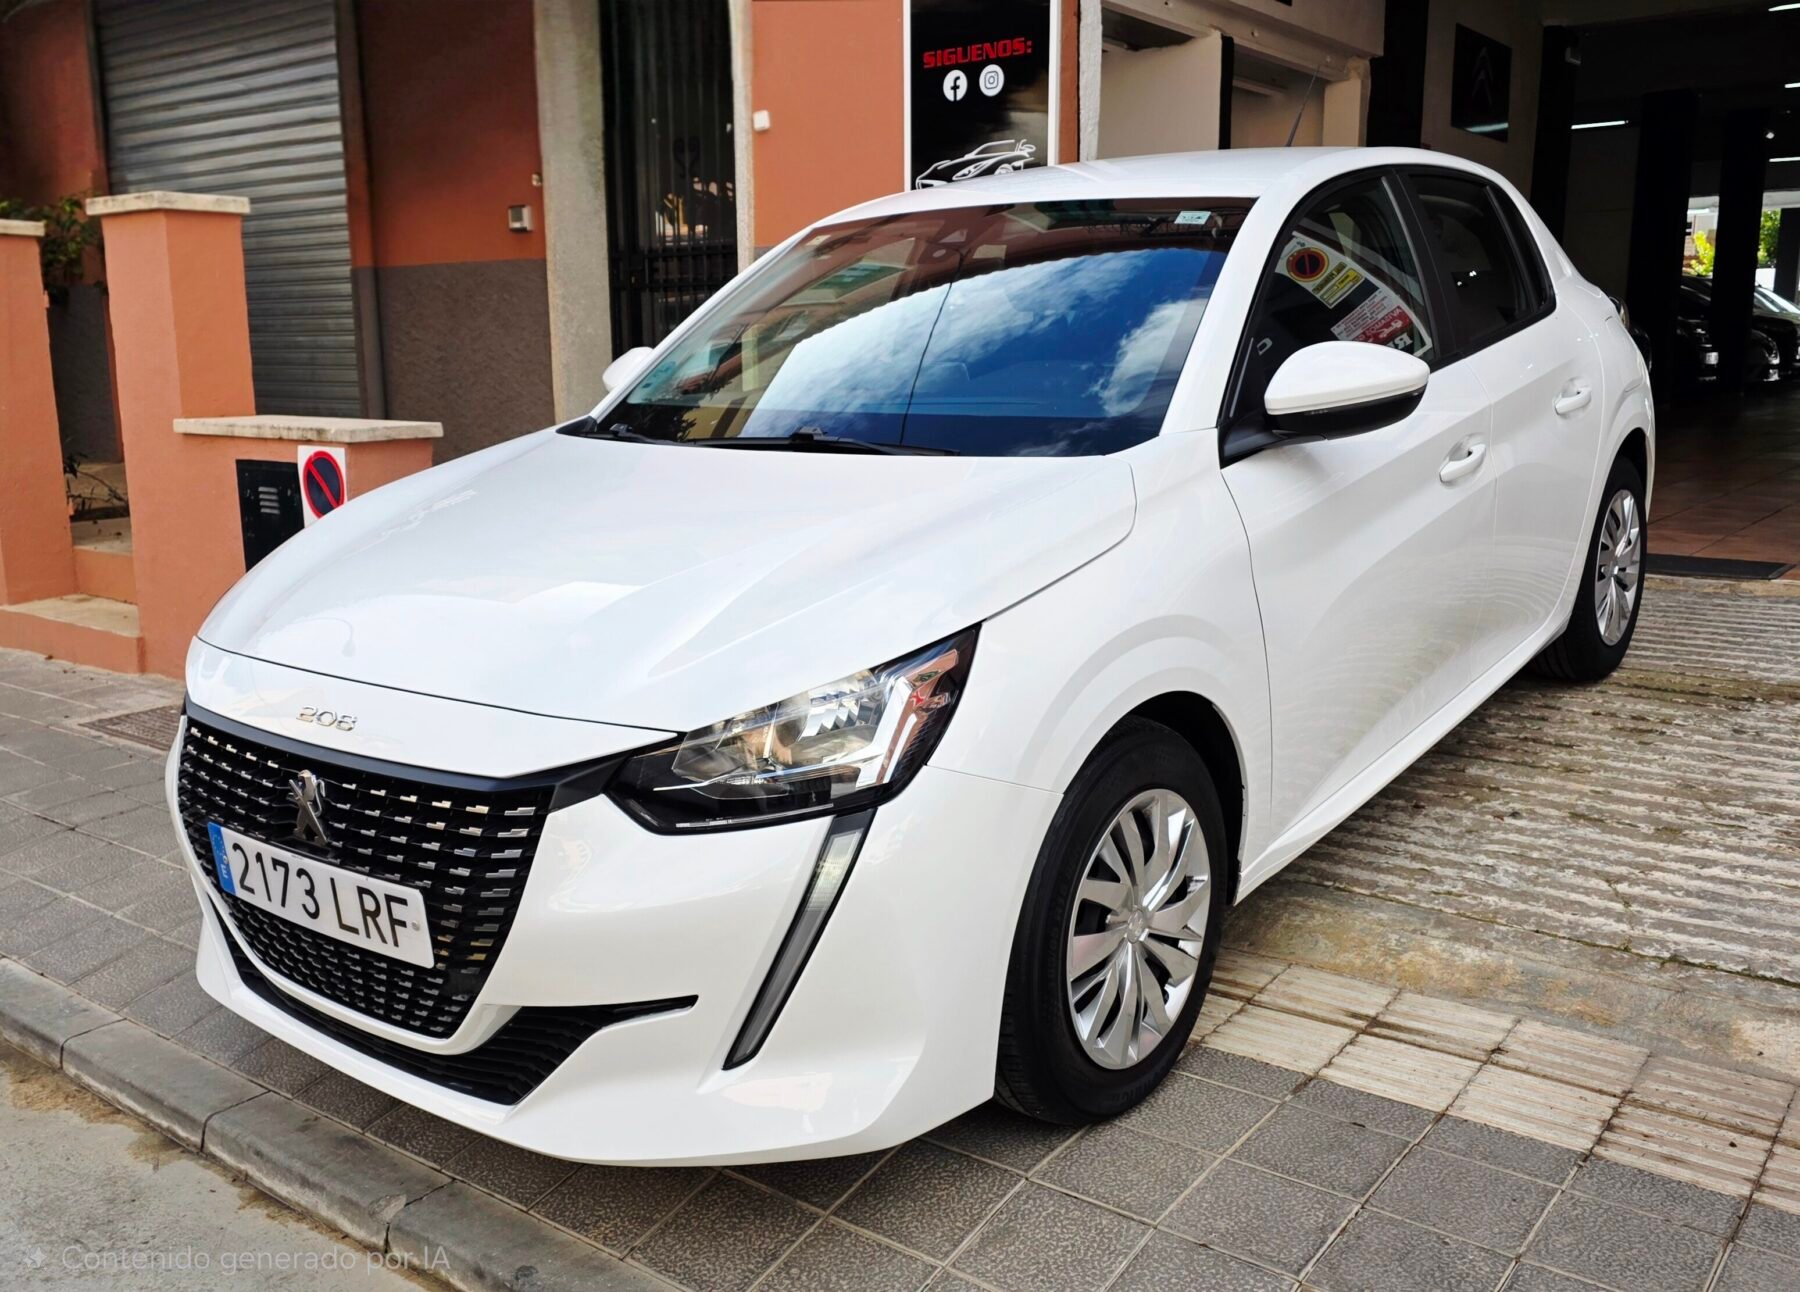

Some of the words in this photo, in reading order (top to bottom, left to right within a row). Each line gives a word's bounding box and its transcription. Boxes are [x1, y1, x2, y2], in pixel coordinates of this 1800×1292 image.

[923, 37, 1032, 68] SIGUENOS:
[232, 842, 320, 920] 2173
[330, 877, 409, 948] LRF
